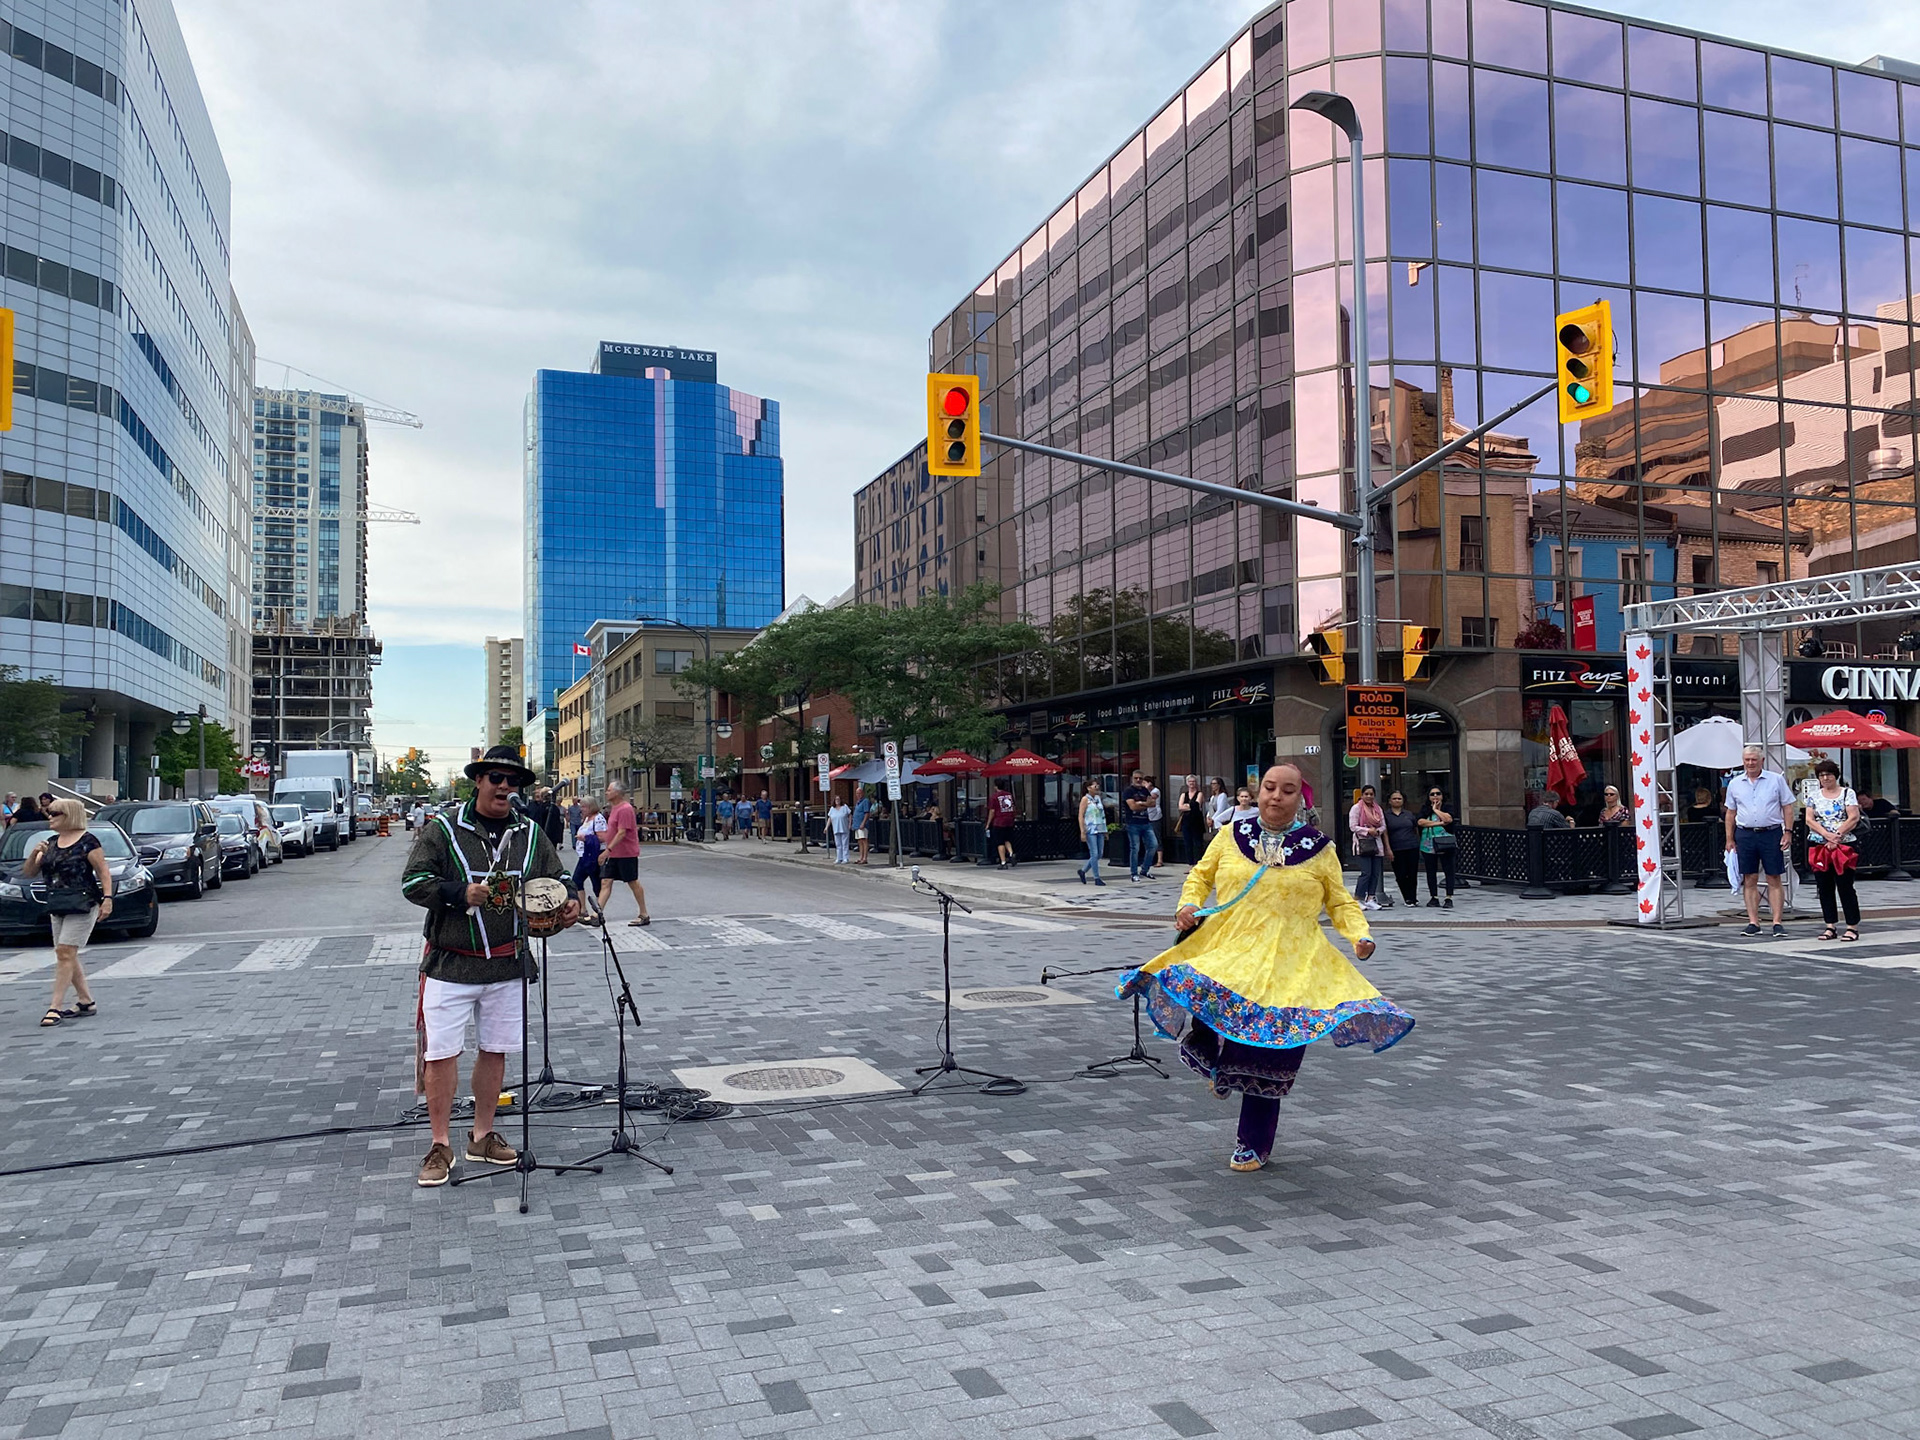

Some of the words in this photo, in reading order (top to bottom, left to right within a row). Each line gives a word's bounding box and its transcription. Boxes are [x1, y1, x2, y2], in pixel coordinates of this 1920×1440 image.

[680, 351, 714, 362] LAKE
[1533, 670, 1565, 682] FITZ
[1653, 674, 1726, 685] aurant
[1213, 688, 1231, 700] FITZ
[1359, 693, 1393, 703] ROAD
[1097, 708, 1112, 718] Food
[1118, 705, 1138, 715] Drinks
[1144, 695, 1195, 711] Entertainment
[1353, 705, 1399, 715] CLOSED
[1357, 718, 1385, 727] Talbot
[1387, 719, 1396, 727] St
